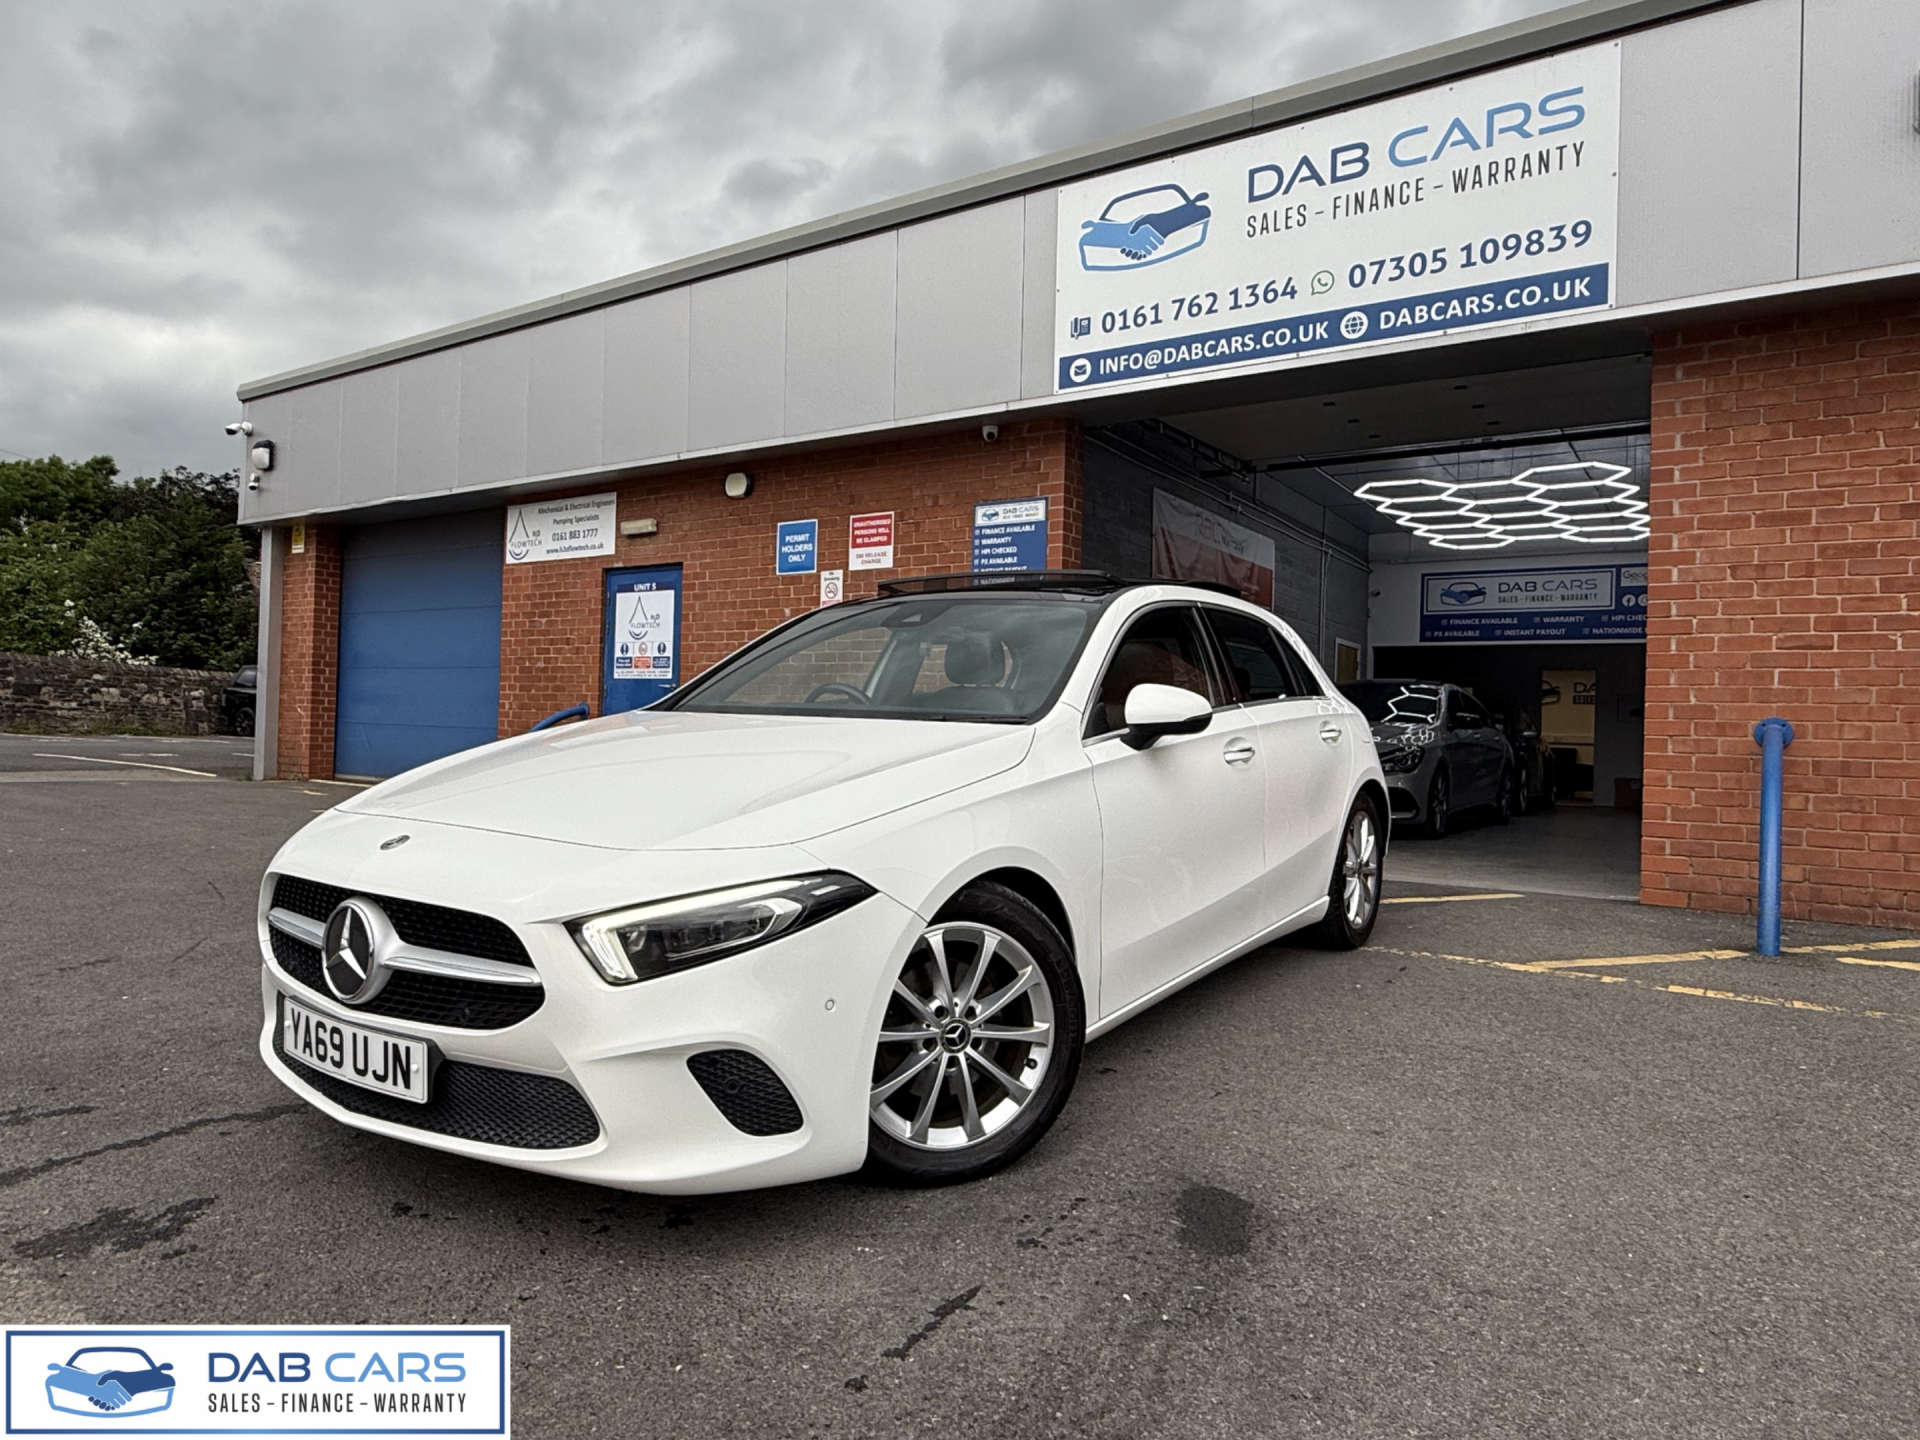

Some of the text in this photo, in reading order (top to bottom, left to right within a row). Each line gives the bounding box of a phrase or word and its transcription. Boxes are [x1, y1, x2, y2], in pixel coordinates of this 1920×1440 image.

[1248, 86, 1585, 203] DAB CARS
[1247, 204, 1307, 238] SALES
[1332, 177, 1424, 220] FINANCE
[1452, 141, 1585, 193] WARRANTY
[1348, 219, 1592, 289] 07305 109839
[1101, 276, 1298, 334] 0161 762 1364
[1379, 276, 1591, 330] DABCARS.CO.UK
[1099, 321, 1329, 375] INFO@DABCARS.CO.UK
[551, 531, 568, 542] 0161
[582, 527, 598, 538] 1777
[981, 524, 1035, 535] FINANCE AVAILABLE
[785, 533, 810, 543] PERMIT
[981, 535, 1013, 545] WARRANTY
[781, 543, 813, 553] HOLDERS
[991, 546, 1018, 554] CHECKED
[787, 553, 806, 563] ONLY
[989, 556, 1018, 564] AVAILABLE
[633, 582, 657, 592] UNIT 5
[1498, 578, 1598, 594] DAB CARS
[1481, 616, 1518, 625] AVAILABLE
[1542, 615, 1585, 623] WARRANTY
[1444, 629, 1480, 637] AVAILABLE
[1503, 627, 1566, 636] INSTANT PAYOUT
[1592, 626, 1643, 635] NATIONWIDE
[291, 1008, 411, 1090] YA69 UJN
